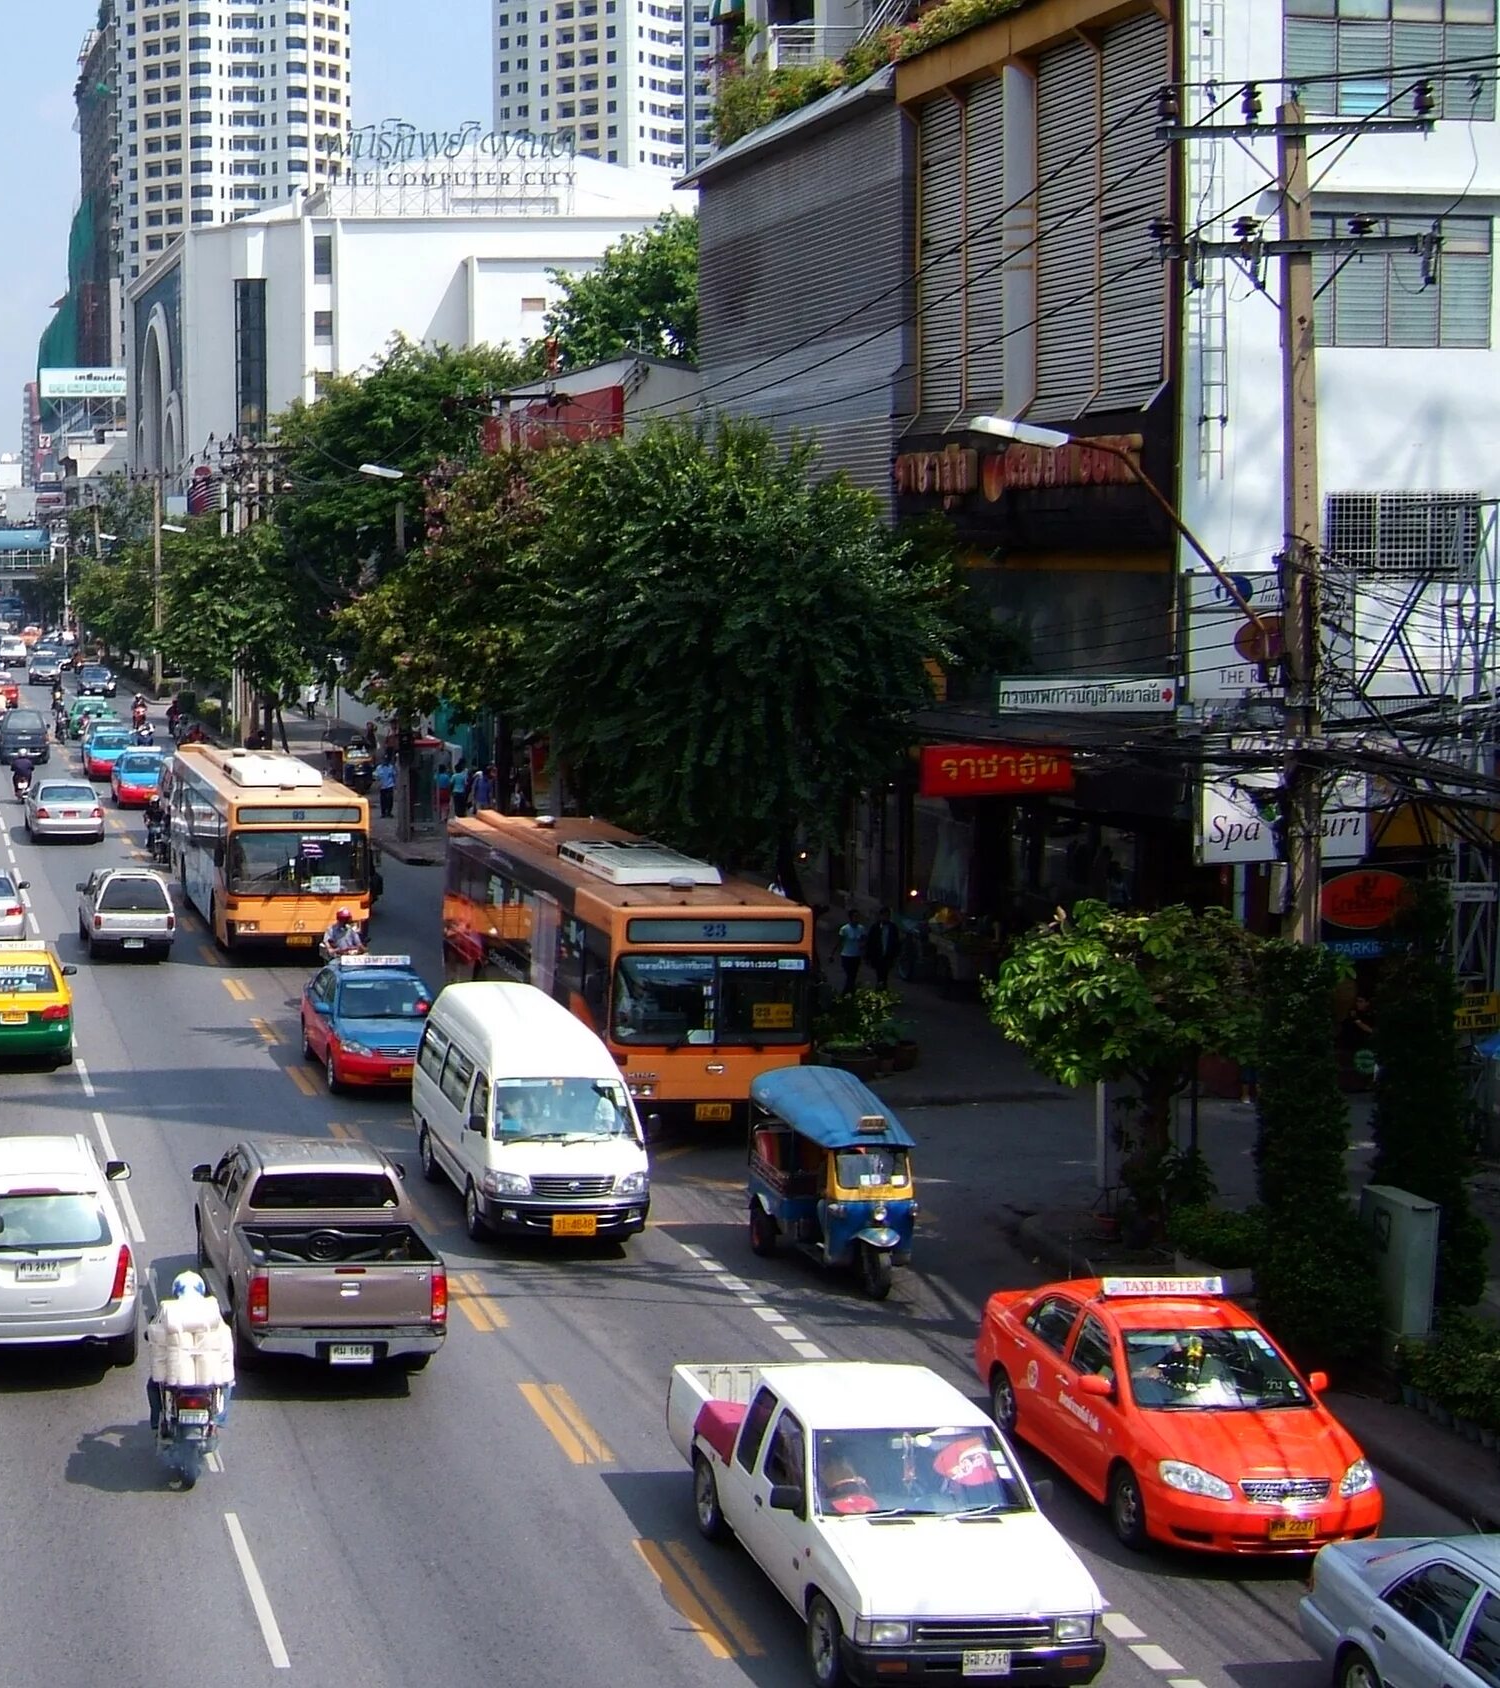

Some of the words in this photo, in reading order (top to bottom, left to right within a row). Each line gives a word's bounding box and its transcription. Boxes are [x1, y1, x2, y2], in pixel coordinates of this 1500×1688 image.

[332, 172, 374, 186] THE
[387, 172, 510, 186] COMPUTER
[523, 171, 578, 186] CITY
[1219, 669, 1244, 684] THE
[1001, 683, 1161, 710] กรุงเทพการบัญชีวิทยาลัย
[941, 752, 1059, 785] ราชาสูท
[1209, 815, 1260, 851] Spa
[703, 923, 727, 938] 23
